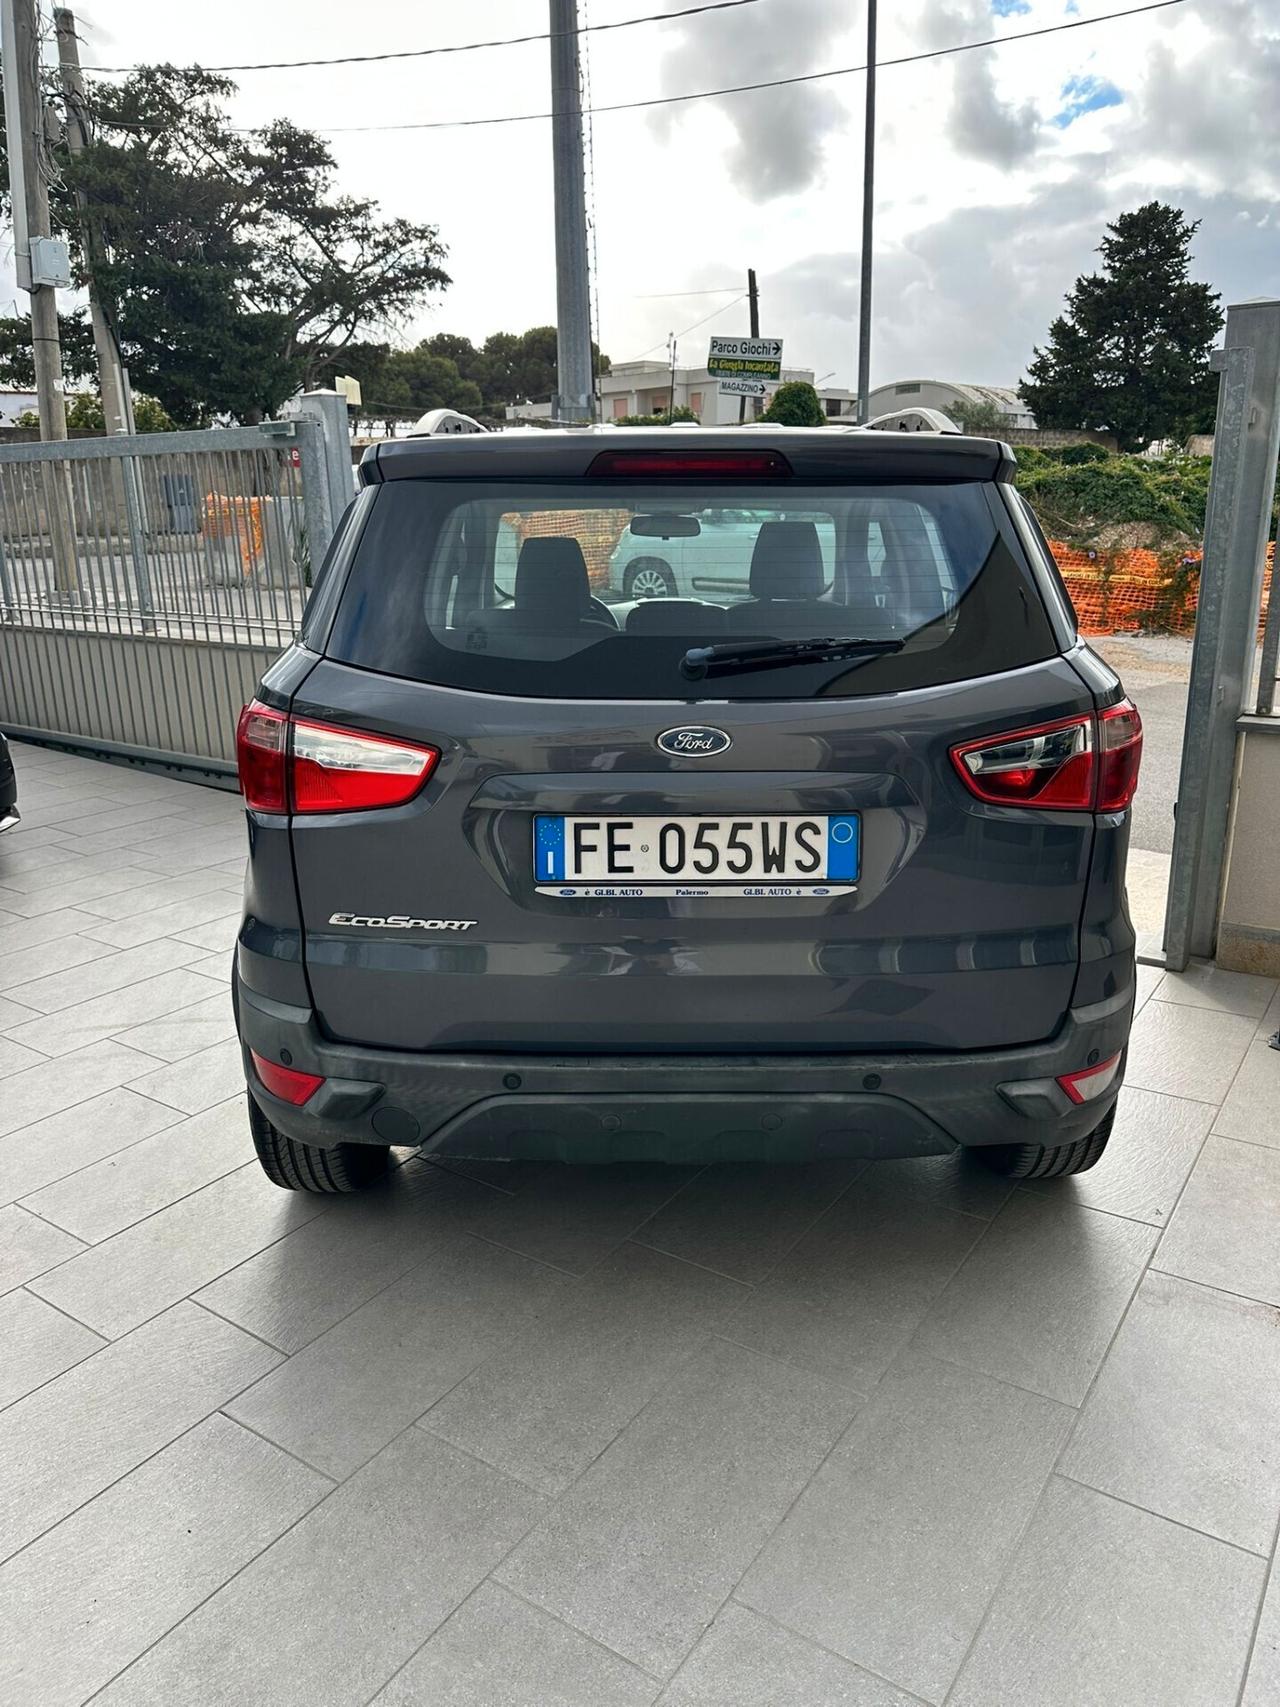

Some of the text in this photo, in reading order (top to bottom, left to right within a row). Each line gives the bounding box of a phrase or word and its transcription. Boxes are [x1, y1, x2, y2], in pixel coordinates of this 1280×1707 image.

[711, 340, 771, 356] Parco Giochi
[721, 382, 758, 393] MAGAZZINO
[673, 731, 714, 750] Ford
[573, 821, 822, 875] FE 055WS
[619, 888, 644, 896] AUTO
[675, 888, 709, 896] Palermo
[768, 888, 792, 896] AUTO
